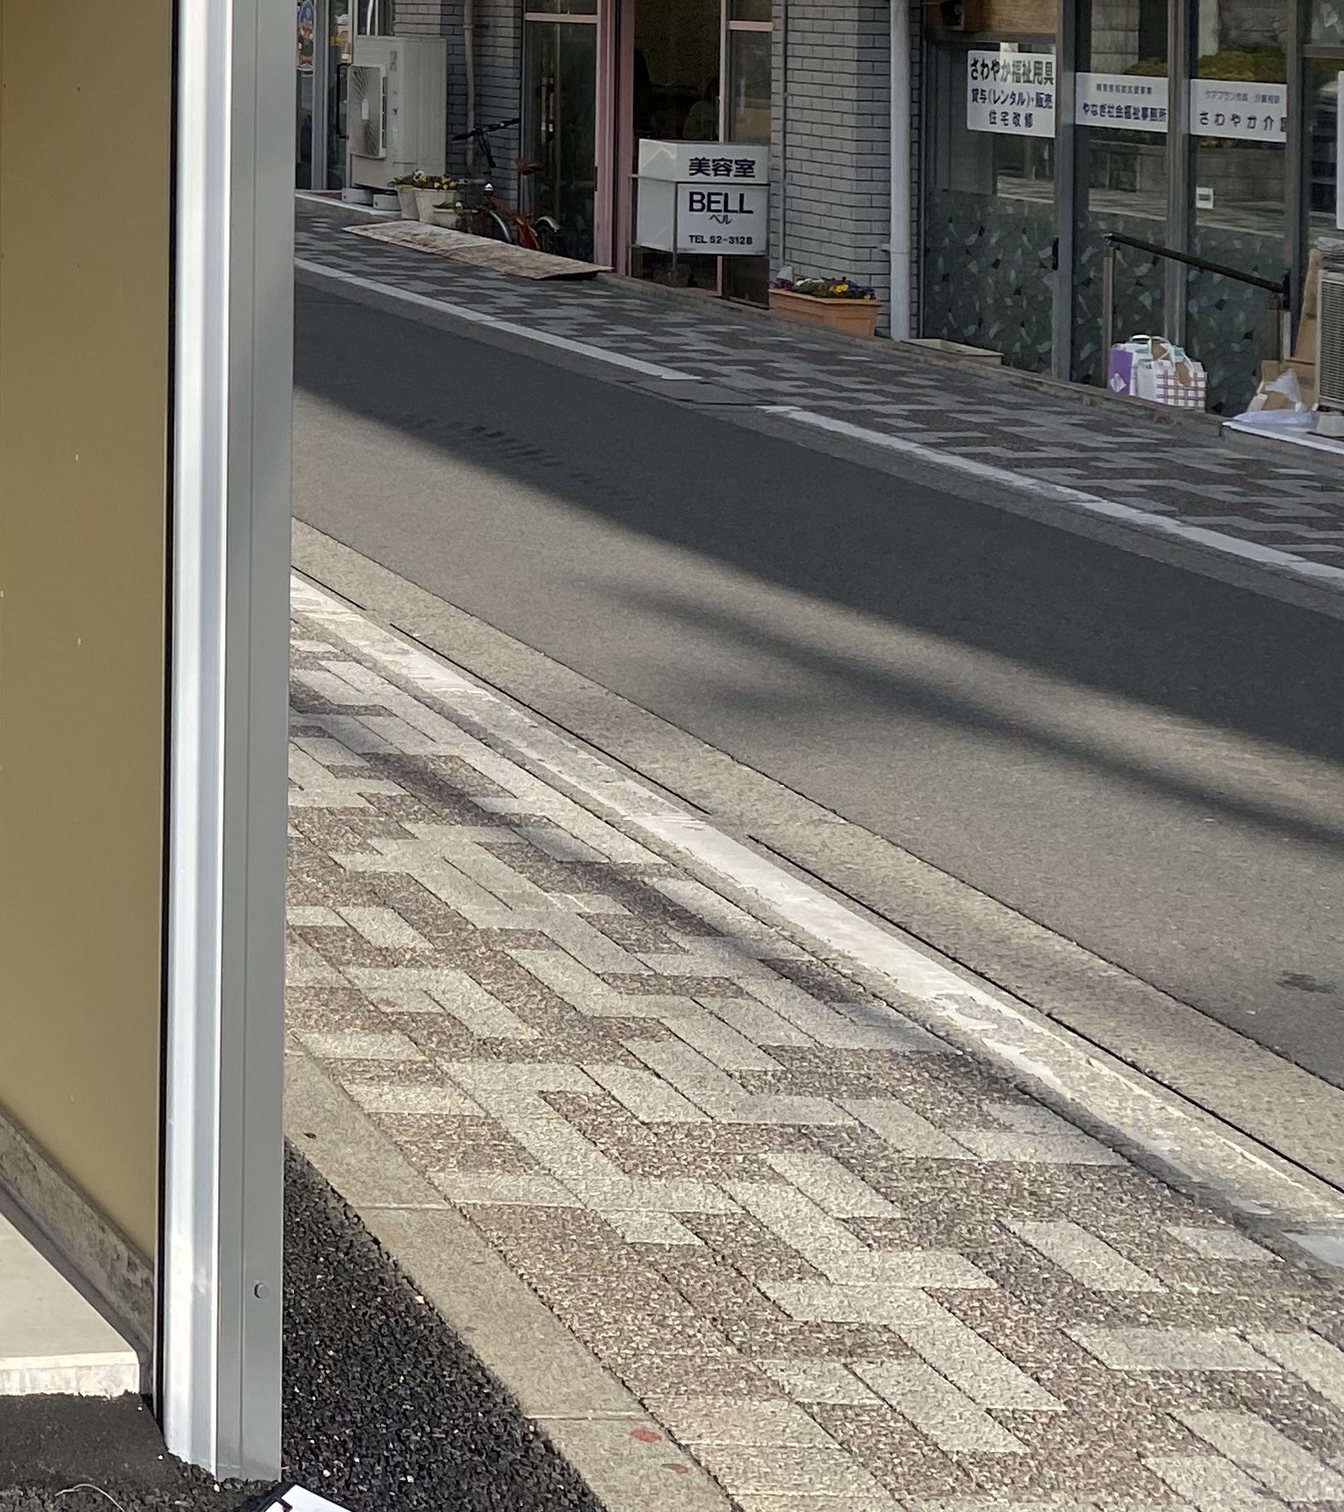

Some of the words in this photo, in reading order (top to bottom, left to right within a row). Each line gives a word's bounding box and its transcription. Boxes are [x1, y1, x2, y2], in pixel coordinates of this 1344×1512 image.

[970, 57, 1055, 86] さわやか福祉用具
[988, 109, 1034, 129] 住宅改修
[688, 156, 757, 179] 美容室
[688, 190, 755, 215] BELL
[708, 214, 733, 225] ベル
[688, 234, 708, 244] TEL
